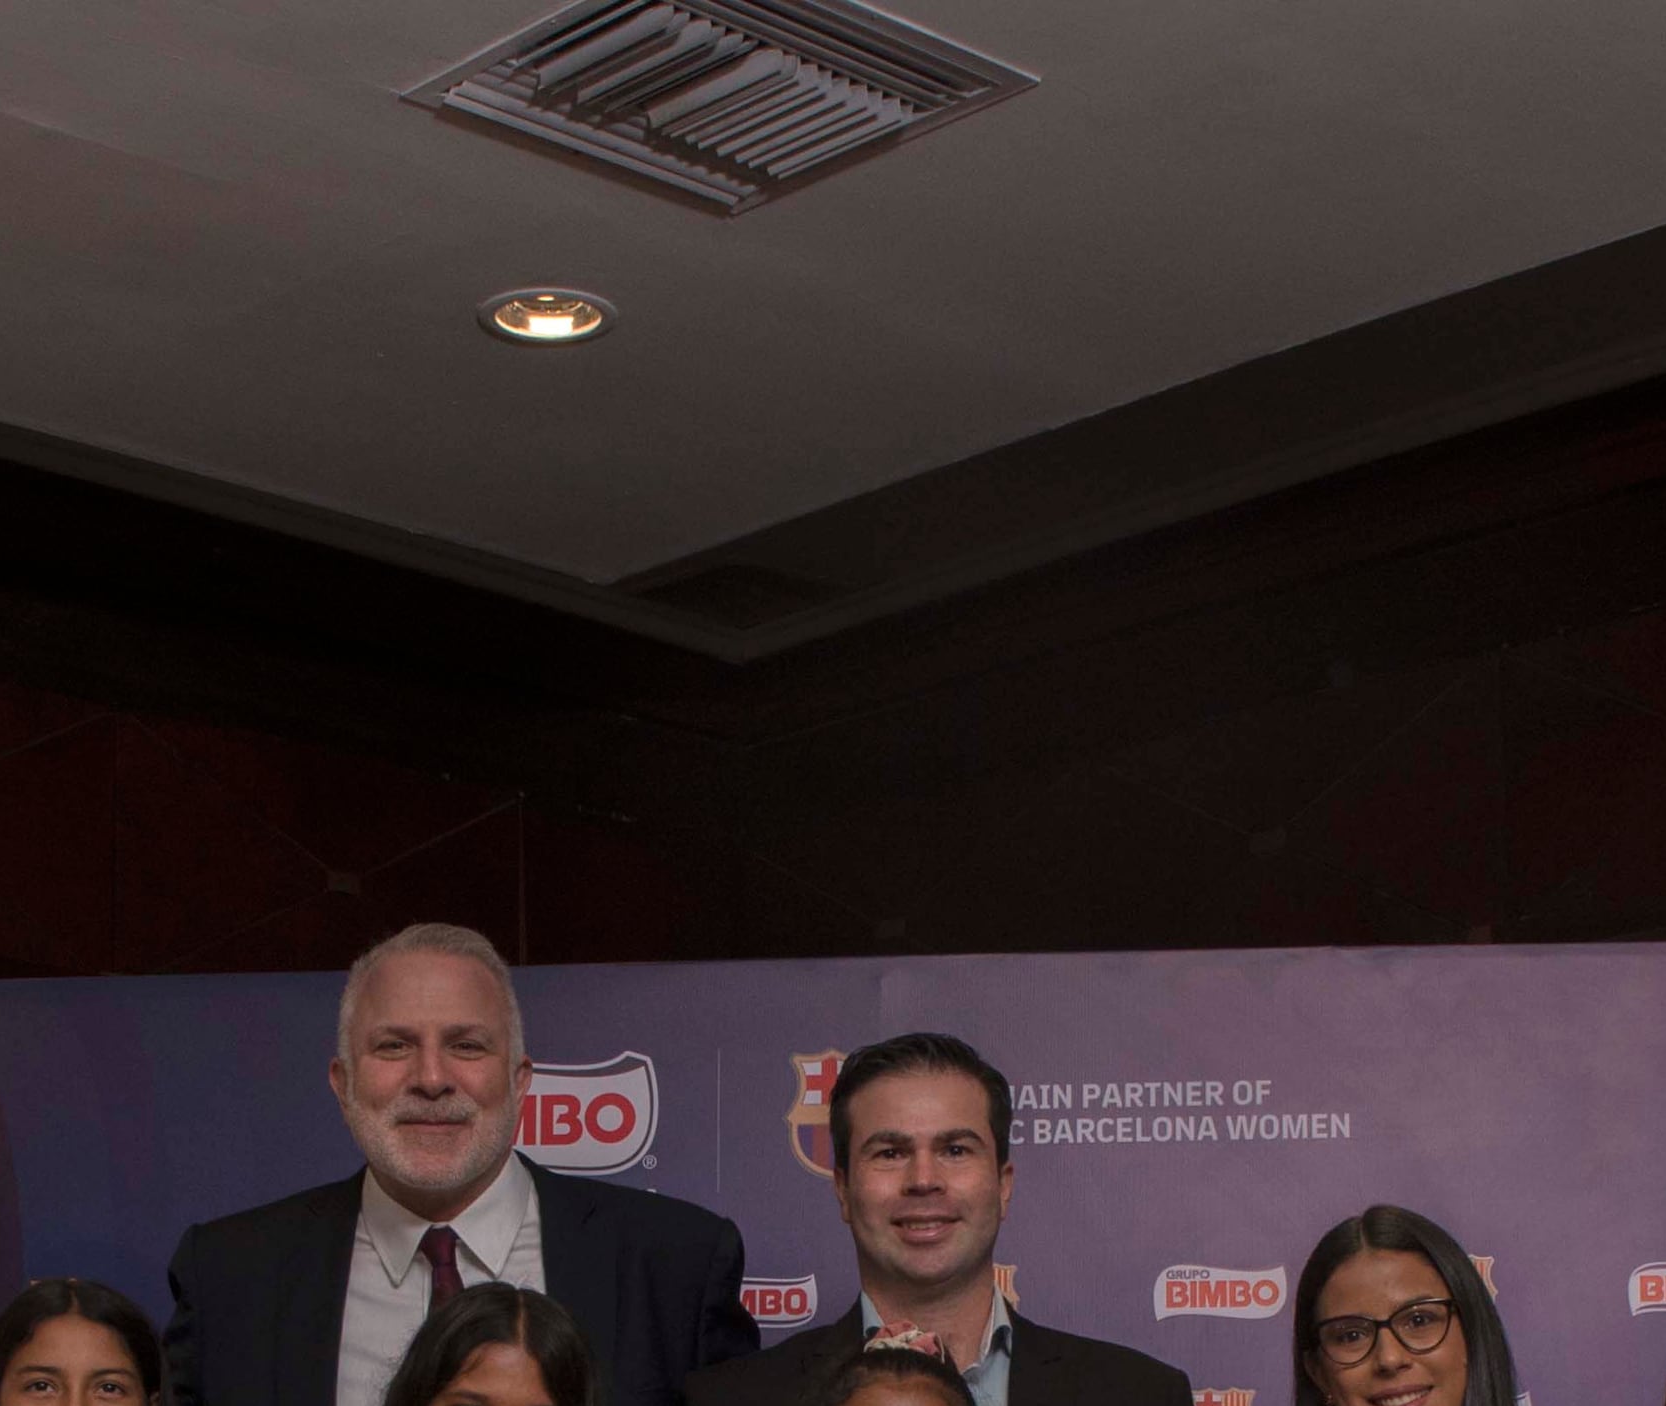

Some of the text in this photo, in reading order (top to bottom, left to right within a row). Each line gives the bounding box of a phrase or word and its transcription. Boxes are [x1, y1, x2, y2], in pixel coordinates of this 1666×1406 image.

[1010, 1080, 1272, 1110] AIN PARTNER OF
[1033, 1116, 1218, 1144] BARCELONA
[1226, 1113, 1350, 1140] WOMEN
[1166, 1269, 1210, 1280] GRUPO
[1166, 1280, 1279, 1308] BIMBO
